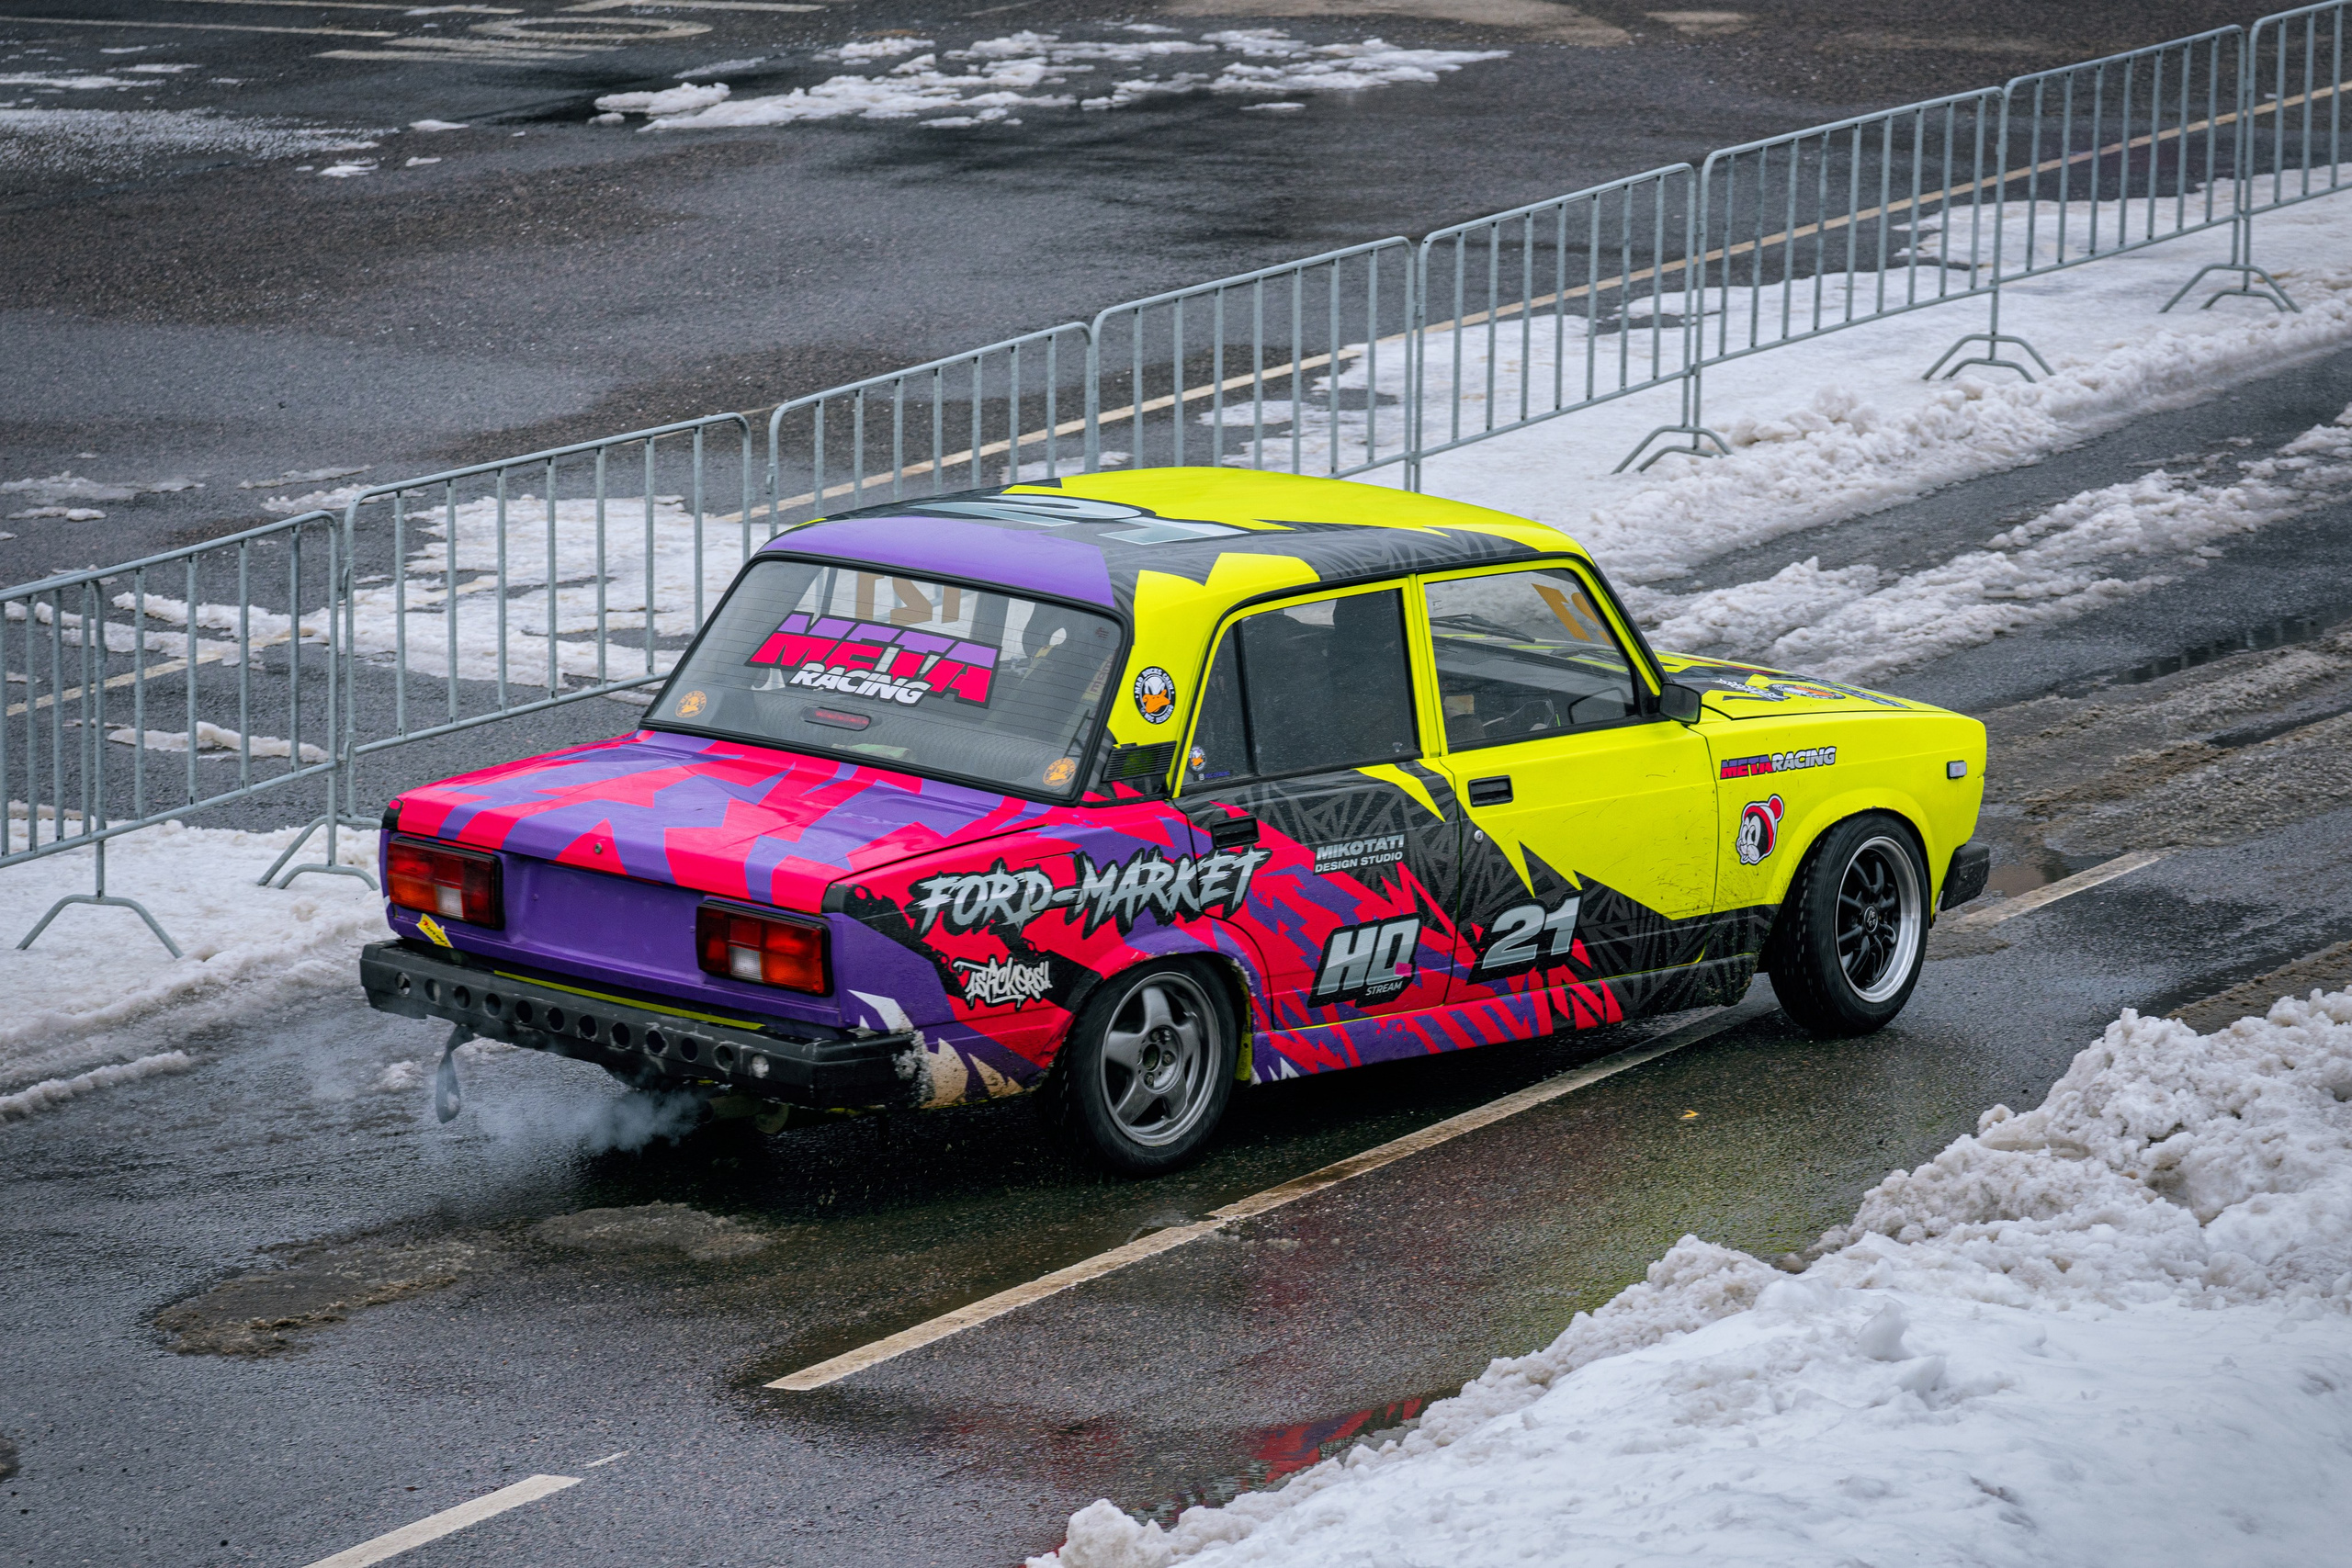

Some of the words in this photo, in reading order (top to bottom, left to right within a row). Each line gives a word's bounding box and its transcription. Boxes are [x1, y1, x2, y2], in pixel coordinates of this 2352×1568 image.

[909, 494, 1251, 546] 21
[747, 612, 1001, 706] META
[788, 662, 932, 705] RACING
[1134, 676, 1144, 694] MAD
[1314, 858, 1358, 874] DESIGN
[1360, 851, 1403, 866] STUDIO
[1316, 834, 1405, 861] MIKOTATI
[918, 847, 1272, 936] FORD-MARKET
[1480, 896, 1582, 970] 21
[1317, 919, 1420, 996] HQ
[1365, 980, 1402, 997] STREAM
